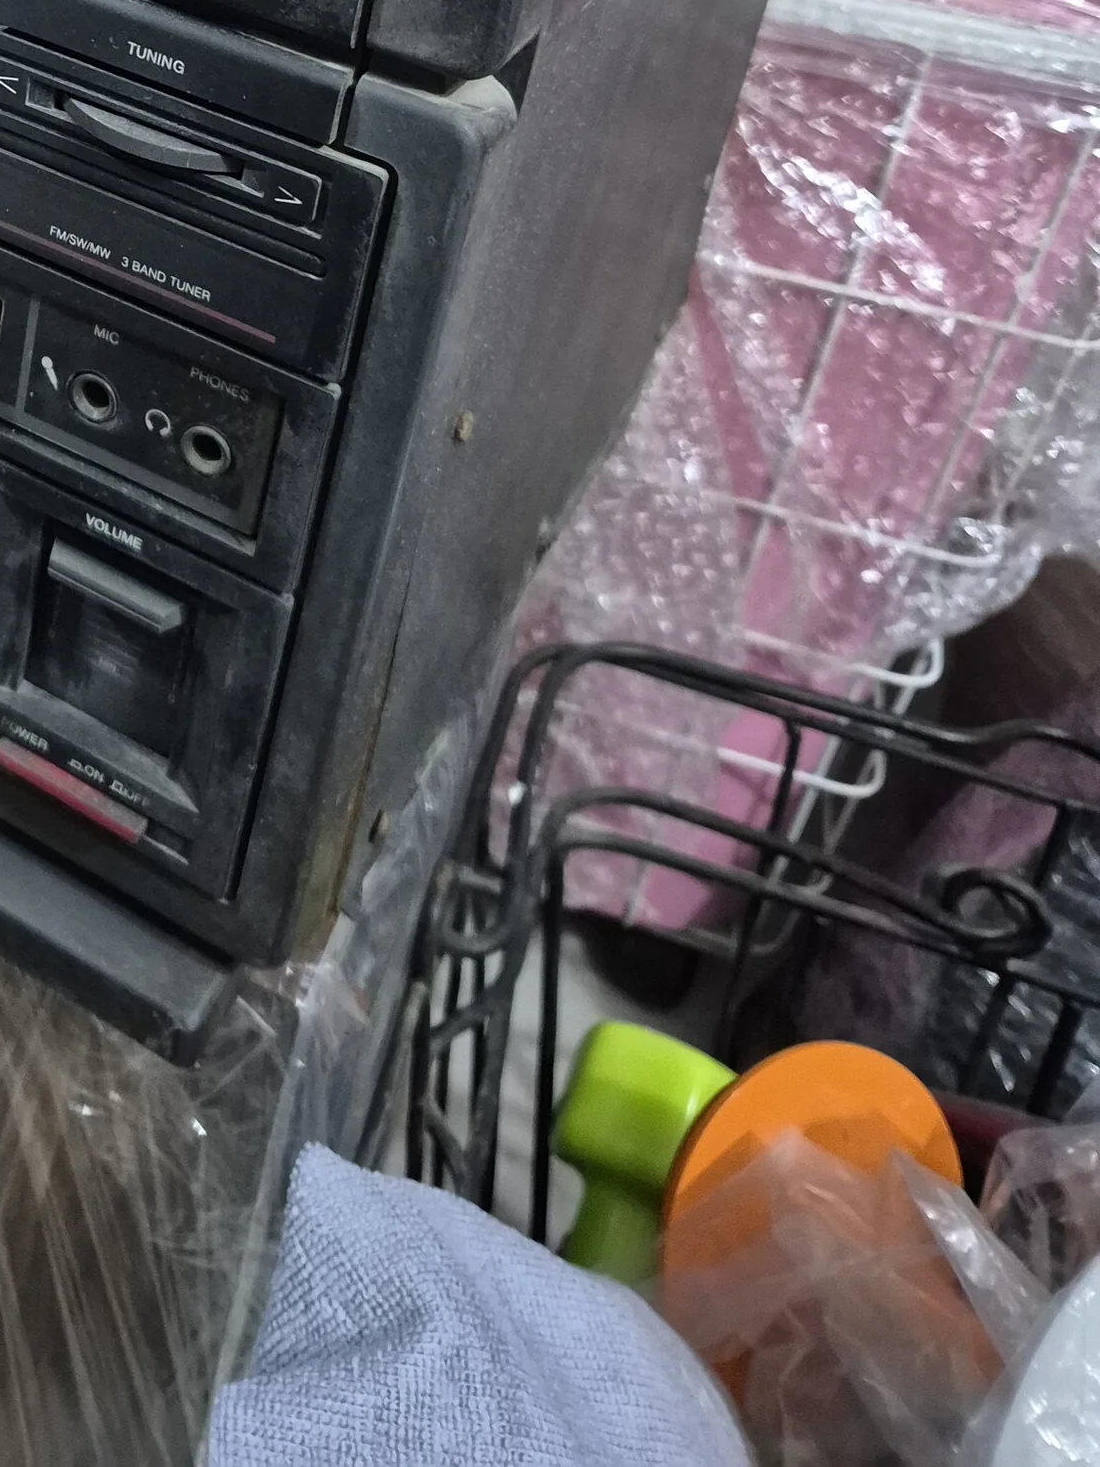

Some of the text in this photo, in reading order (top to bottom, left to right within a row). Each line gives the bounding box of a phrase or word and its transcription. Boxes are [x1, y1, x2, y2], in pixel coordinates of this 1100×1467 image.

[127, 41, 185, 75] TUNING
[50, 225, 211, 303] FM/SW/MW 3 BAND TUNER
[93, 324, 120, 345] MIC
[189, 366, 250, 403] PHONES
[85, 512, 143, 551] VOLUME
